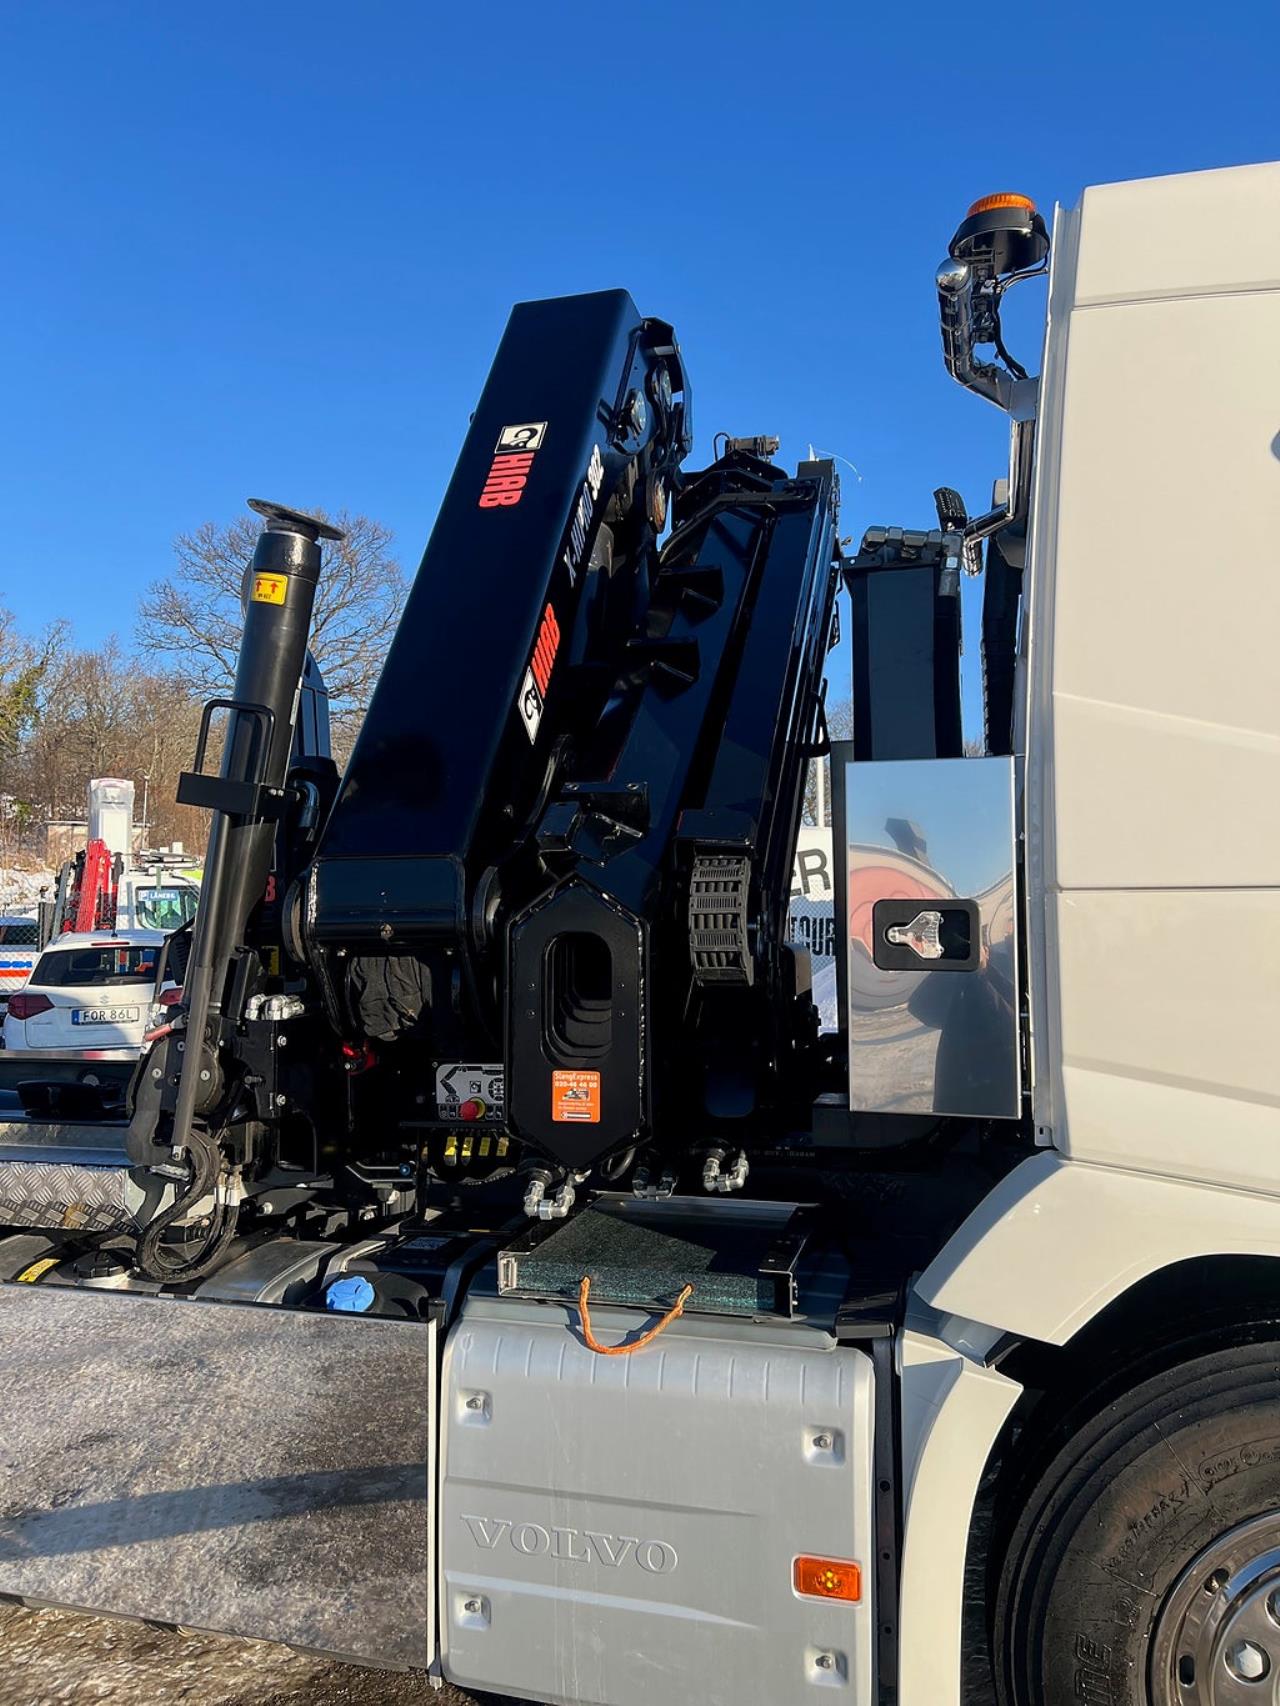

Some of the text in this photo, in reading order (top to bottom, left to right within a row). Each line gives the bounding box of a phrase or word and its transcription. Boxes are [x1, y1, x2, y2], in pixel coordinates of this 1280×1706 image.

[479, 452, 534, 508] HIAB
[531, 602, 560, 699] HIAB
[83, 1010, 106, 1021] FOR
[460, 1513, 679, 1575] VOLVO
